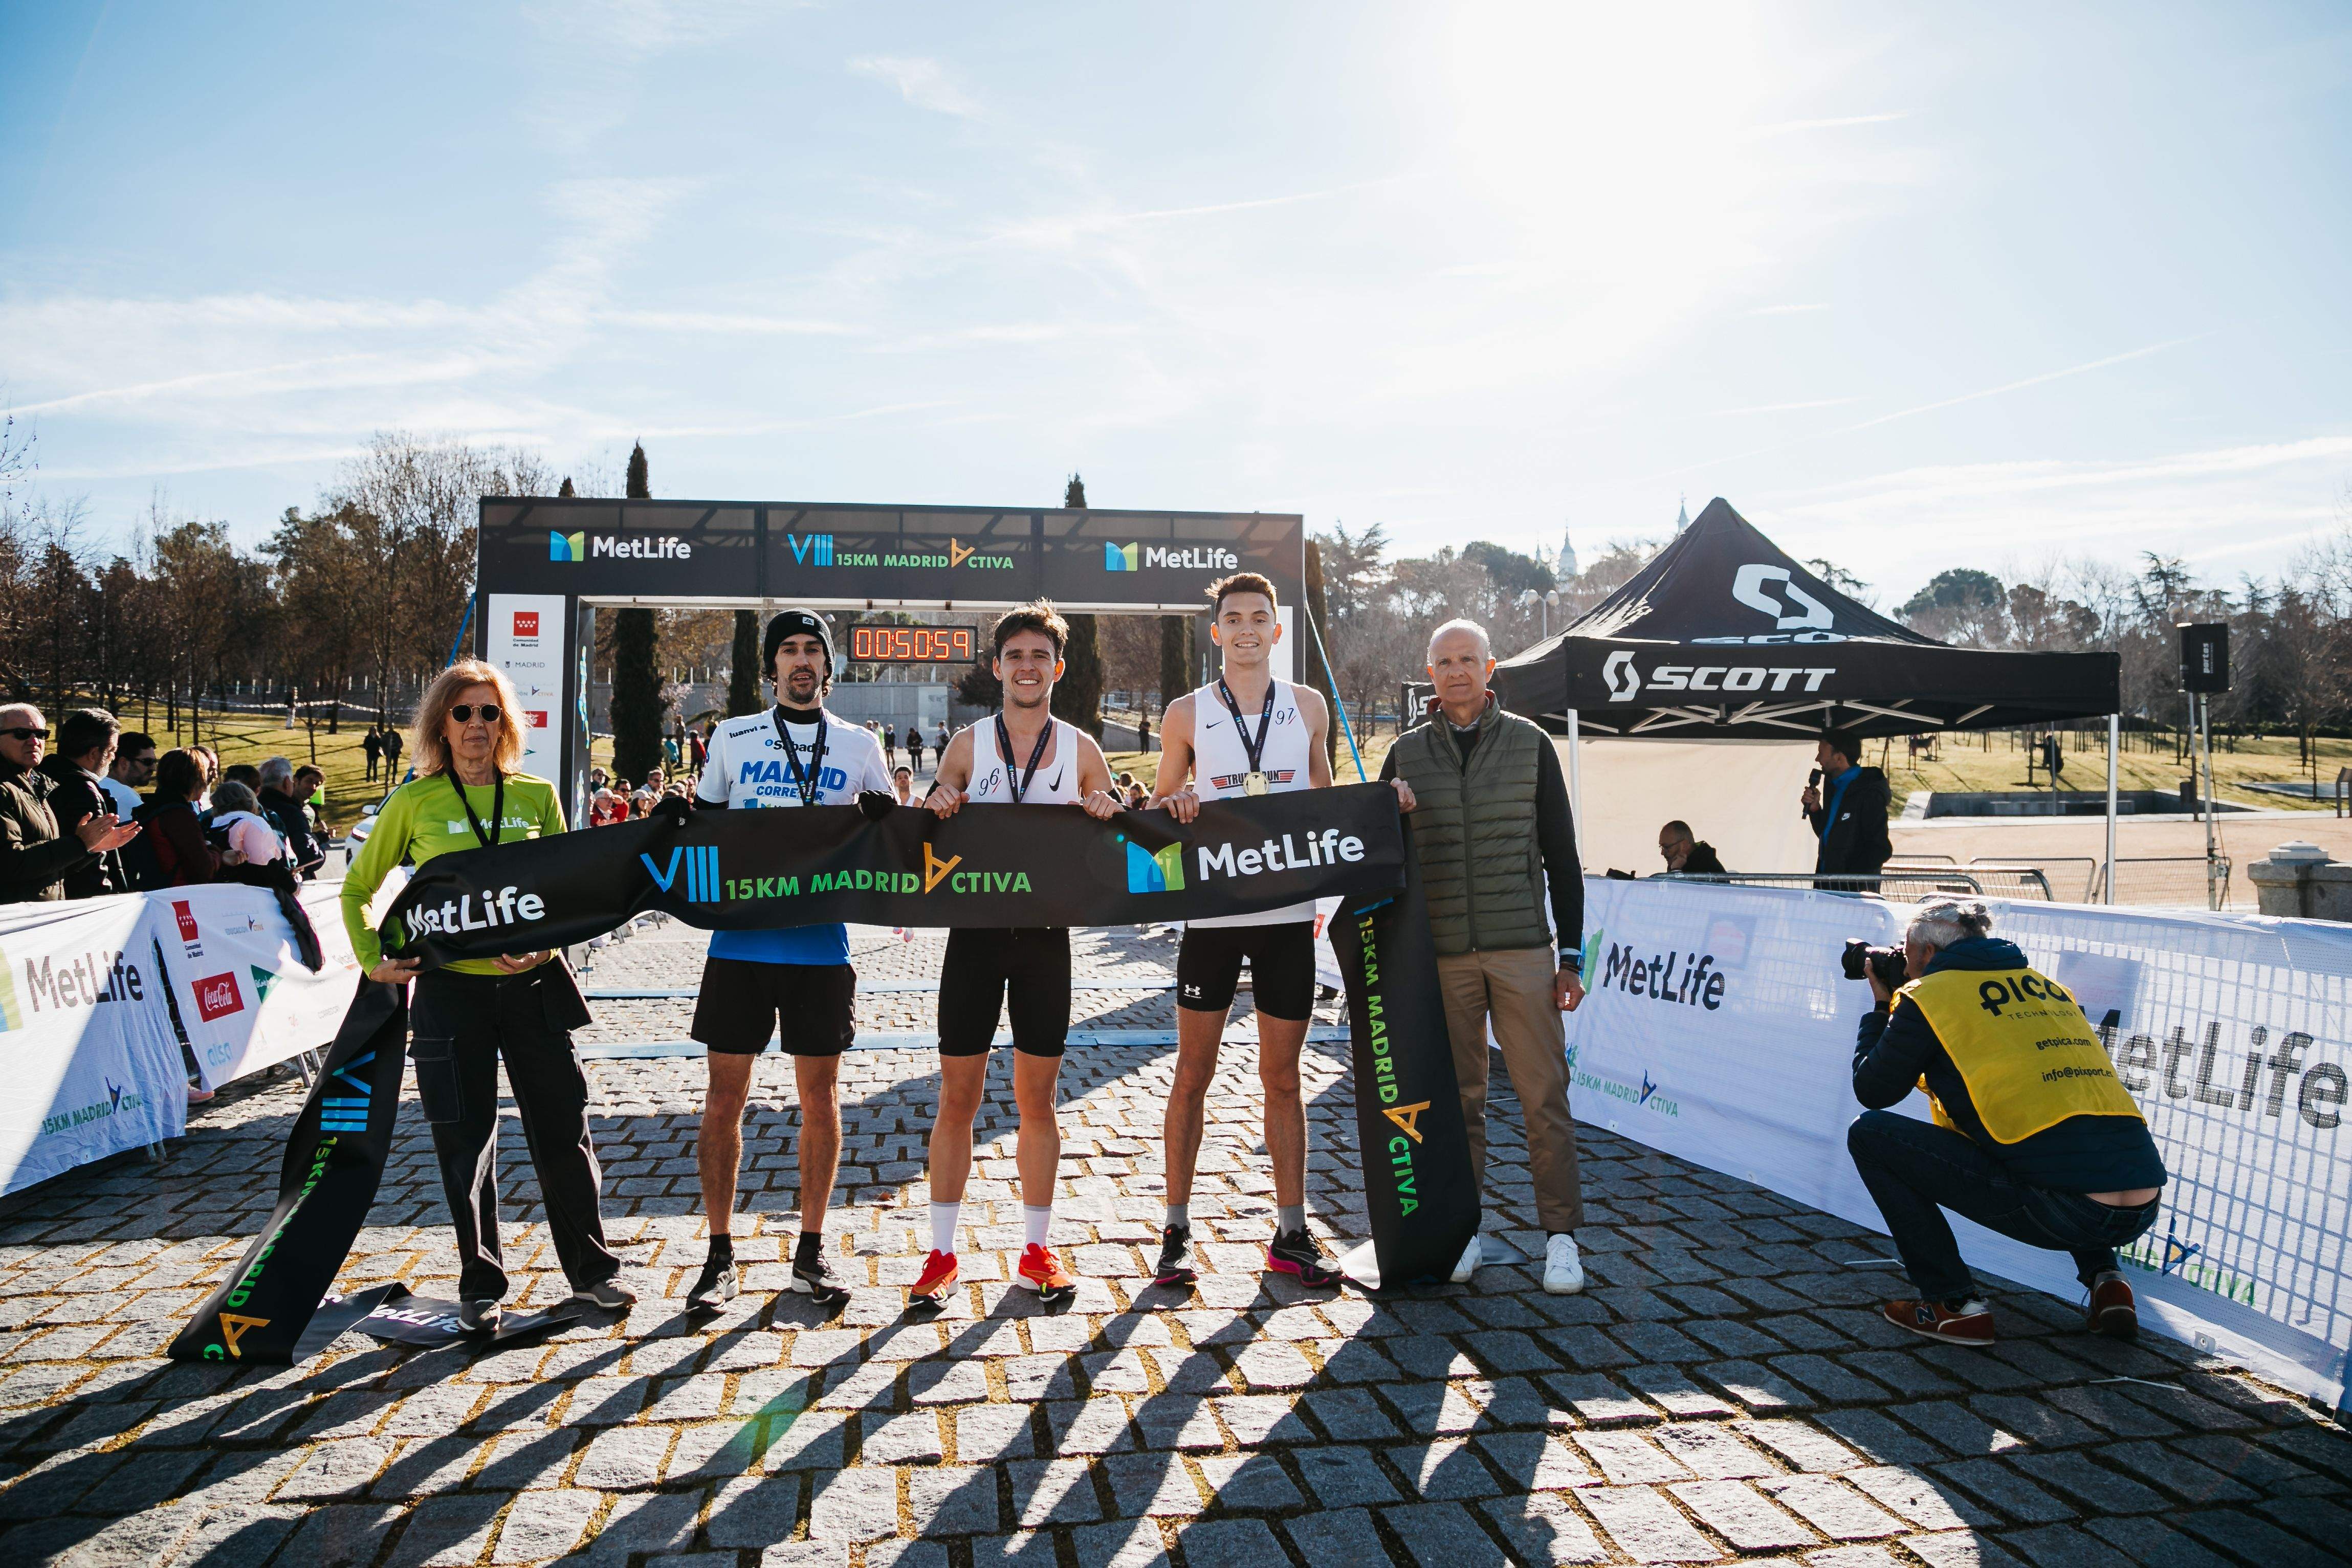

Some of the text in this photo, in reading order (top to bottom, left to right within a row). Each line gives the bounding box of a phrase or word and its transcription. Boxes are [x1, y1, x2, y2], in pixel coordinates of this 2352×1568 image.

[593, 536, 691, 559] MetLife
[787, 534, 832, 566] VIII
[837, 554, 878, 567] 15KM
[884, 554, 949, 568] MADRID
[1146, 547, 1238, 569] MetLife
[855, 629, 969, 659] 00:50:59
[1646, 666, 1836, 691] SCOTT
[1238, 722, 1246, 736] MetLife
[756, 786, 824, 801] CORRER
[1198, 828, 1365, 881] MetLife
[640, 846, 720, 903] VIII
[725, 876, 799, 900] 15KM
[810, 870, 919, 894] MADRID
[406, 886, 545, 943] MetLife
[1359, 917, 1379, 986] 15KM
[26, 951, 144, 1012] MetLife
[1603, 942, 1725, 1011] MetLife
[207, 1041, 232, 1067] alsa
[1368, 995, 1399, 1104] MADRID
[2036, 1037, 2092, 1050] getpica.com
[1576, 1072, 1601, 1091] 15KM
[1604, 1080, 1639, 1103] MADRID
[2042, 1066, 2114, 1082] info@pixport.es
[42, 1113, 71, 1135] 15KM
[73, 1101, 112, 1126] MADRID
[297, 1136, 337, 1205] 15KM
